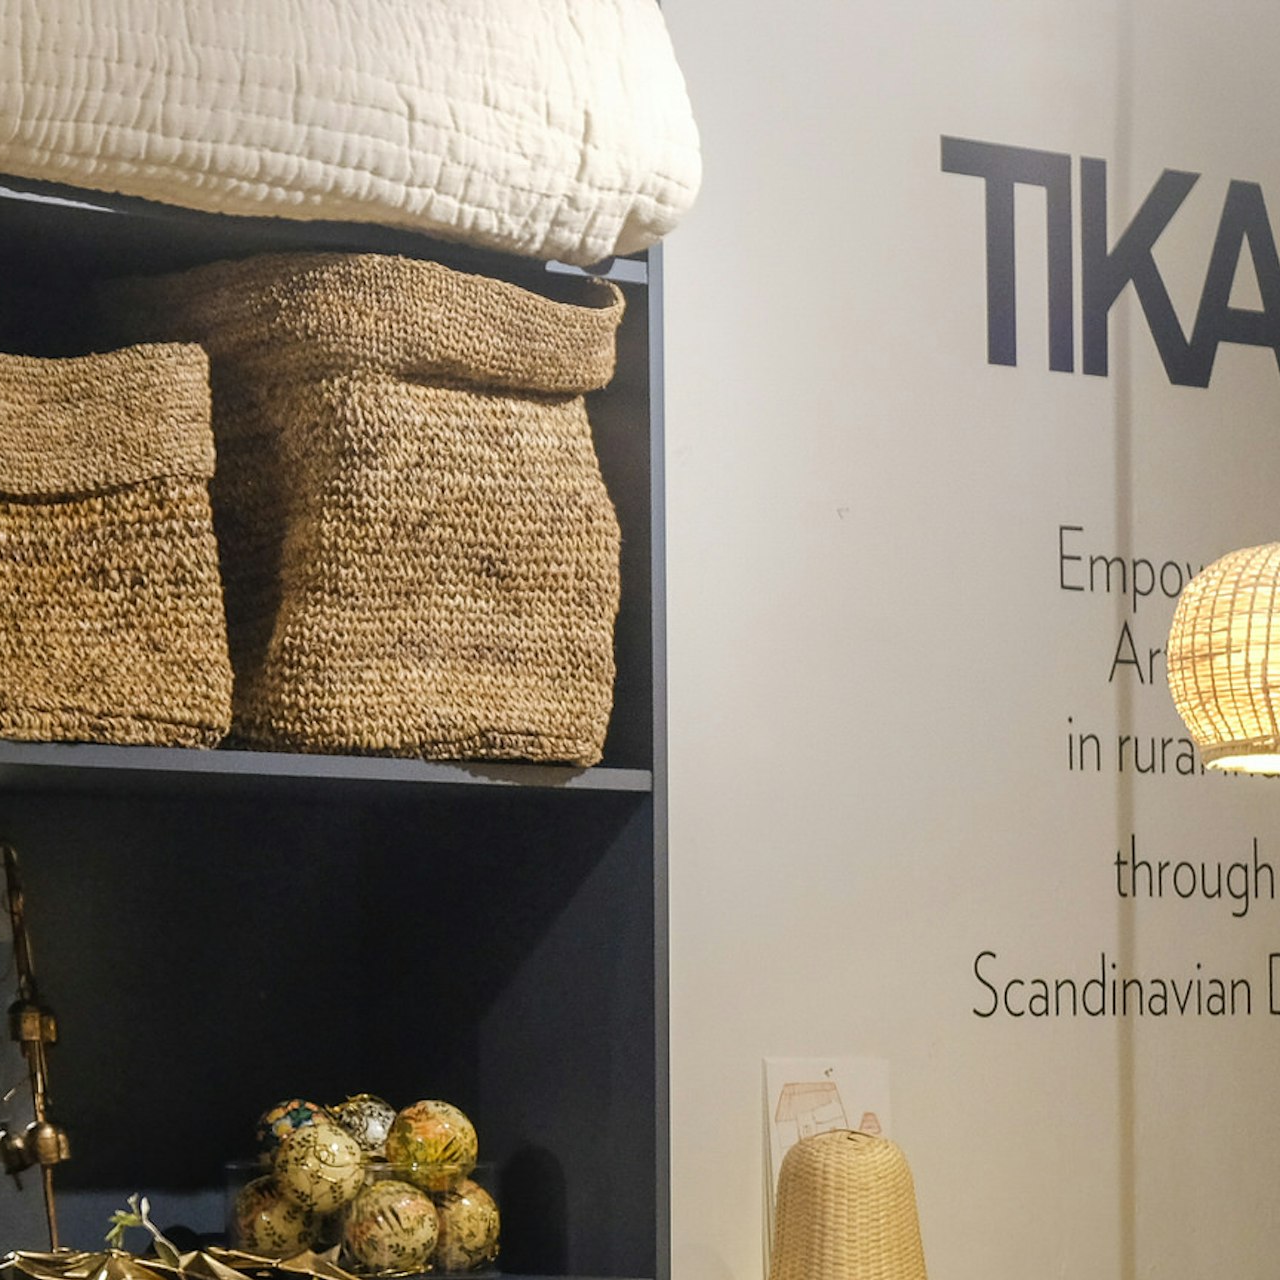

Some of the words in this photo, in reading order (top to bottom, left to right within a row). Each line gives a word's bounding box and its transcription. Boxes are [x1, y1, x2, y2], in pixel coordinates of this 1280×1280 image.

[1067, 717, 1100, 772] in
[1117, 734, 1205, 776] rura
[1114, 834, 1277, 918] through
[972, 950, 1253, 1018] Scandinavian
